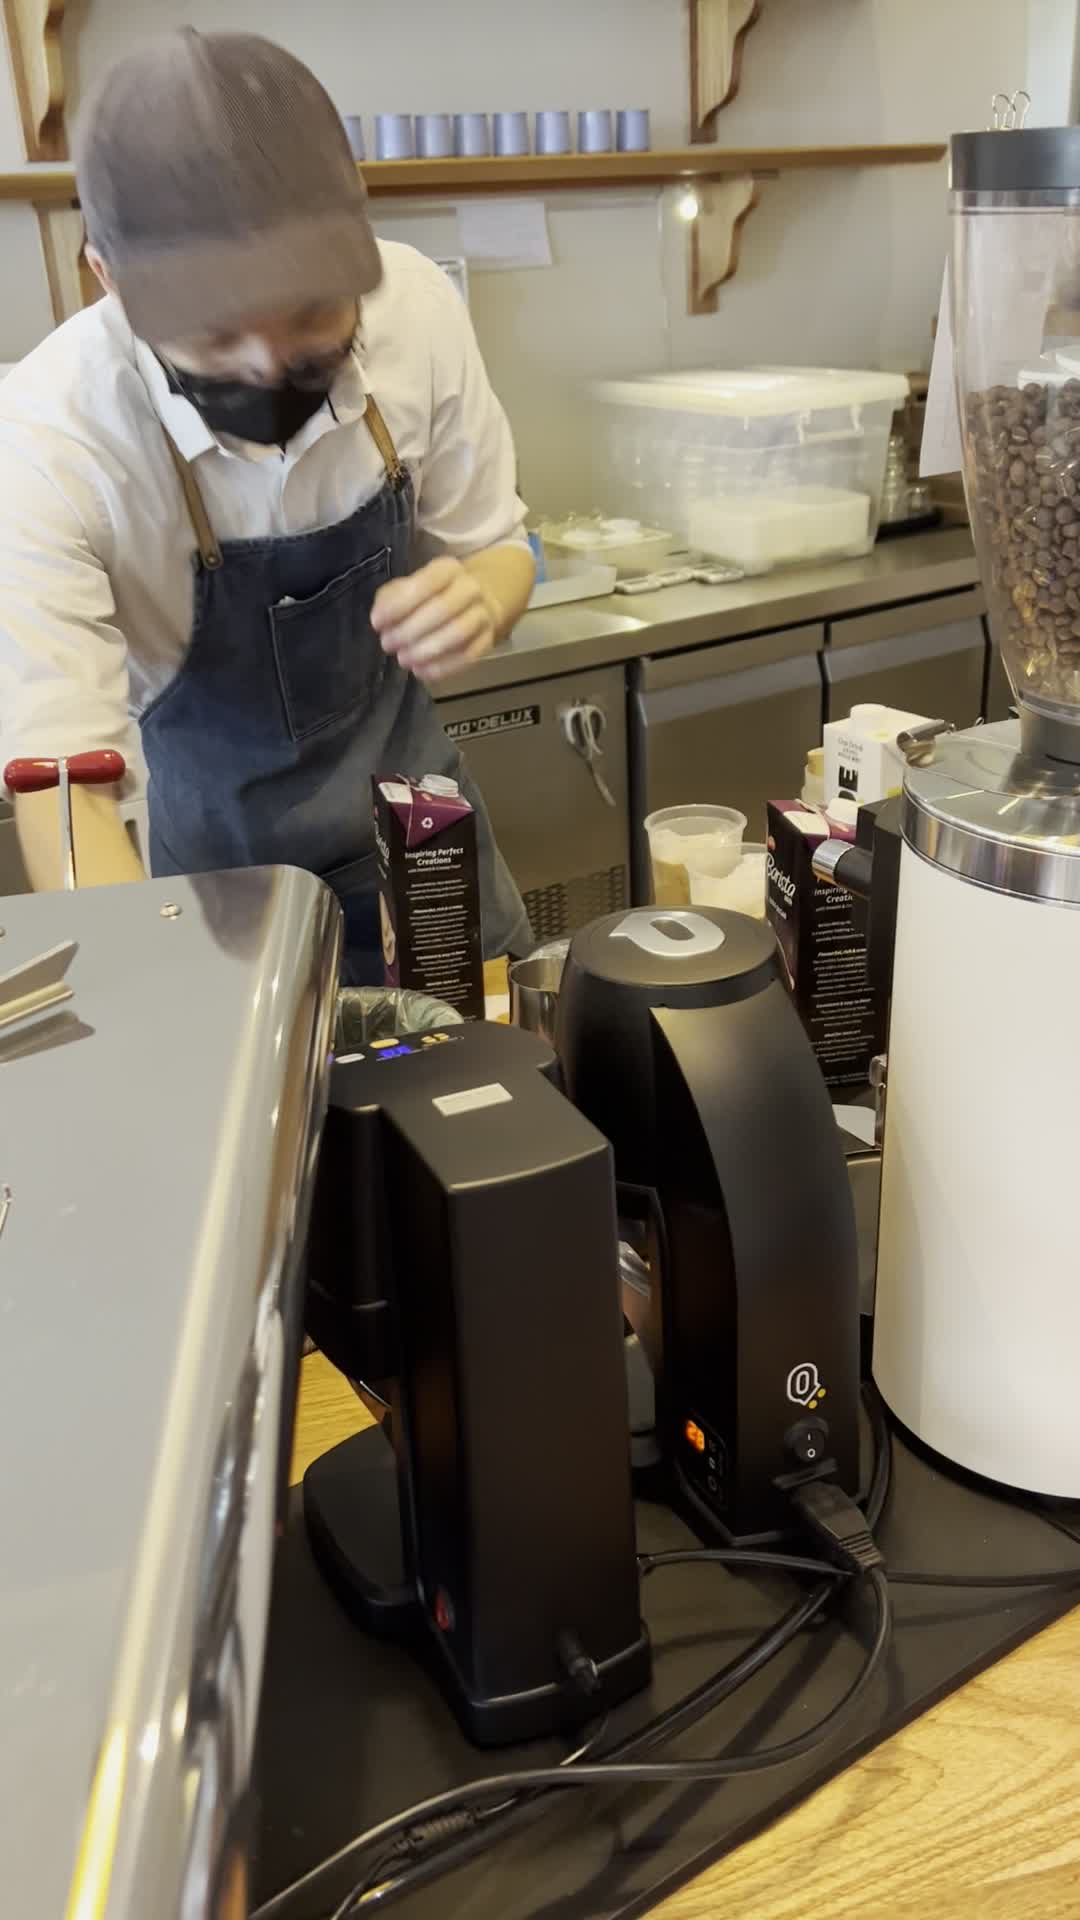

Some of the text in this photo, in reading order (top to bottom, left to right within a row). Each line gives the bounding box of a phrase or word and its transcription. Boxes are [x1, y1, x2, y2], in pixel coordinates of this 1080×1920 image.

[438, 847, 464, 856] Perfect
[416, 857, 452, 866] Creations
[767, 852, 796, 898] Barista
[814, 887, 848, 897] Inspiring
